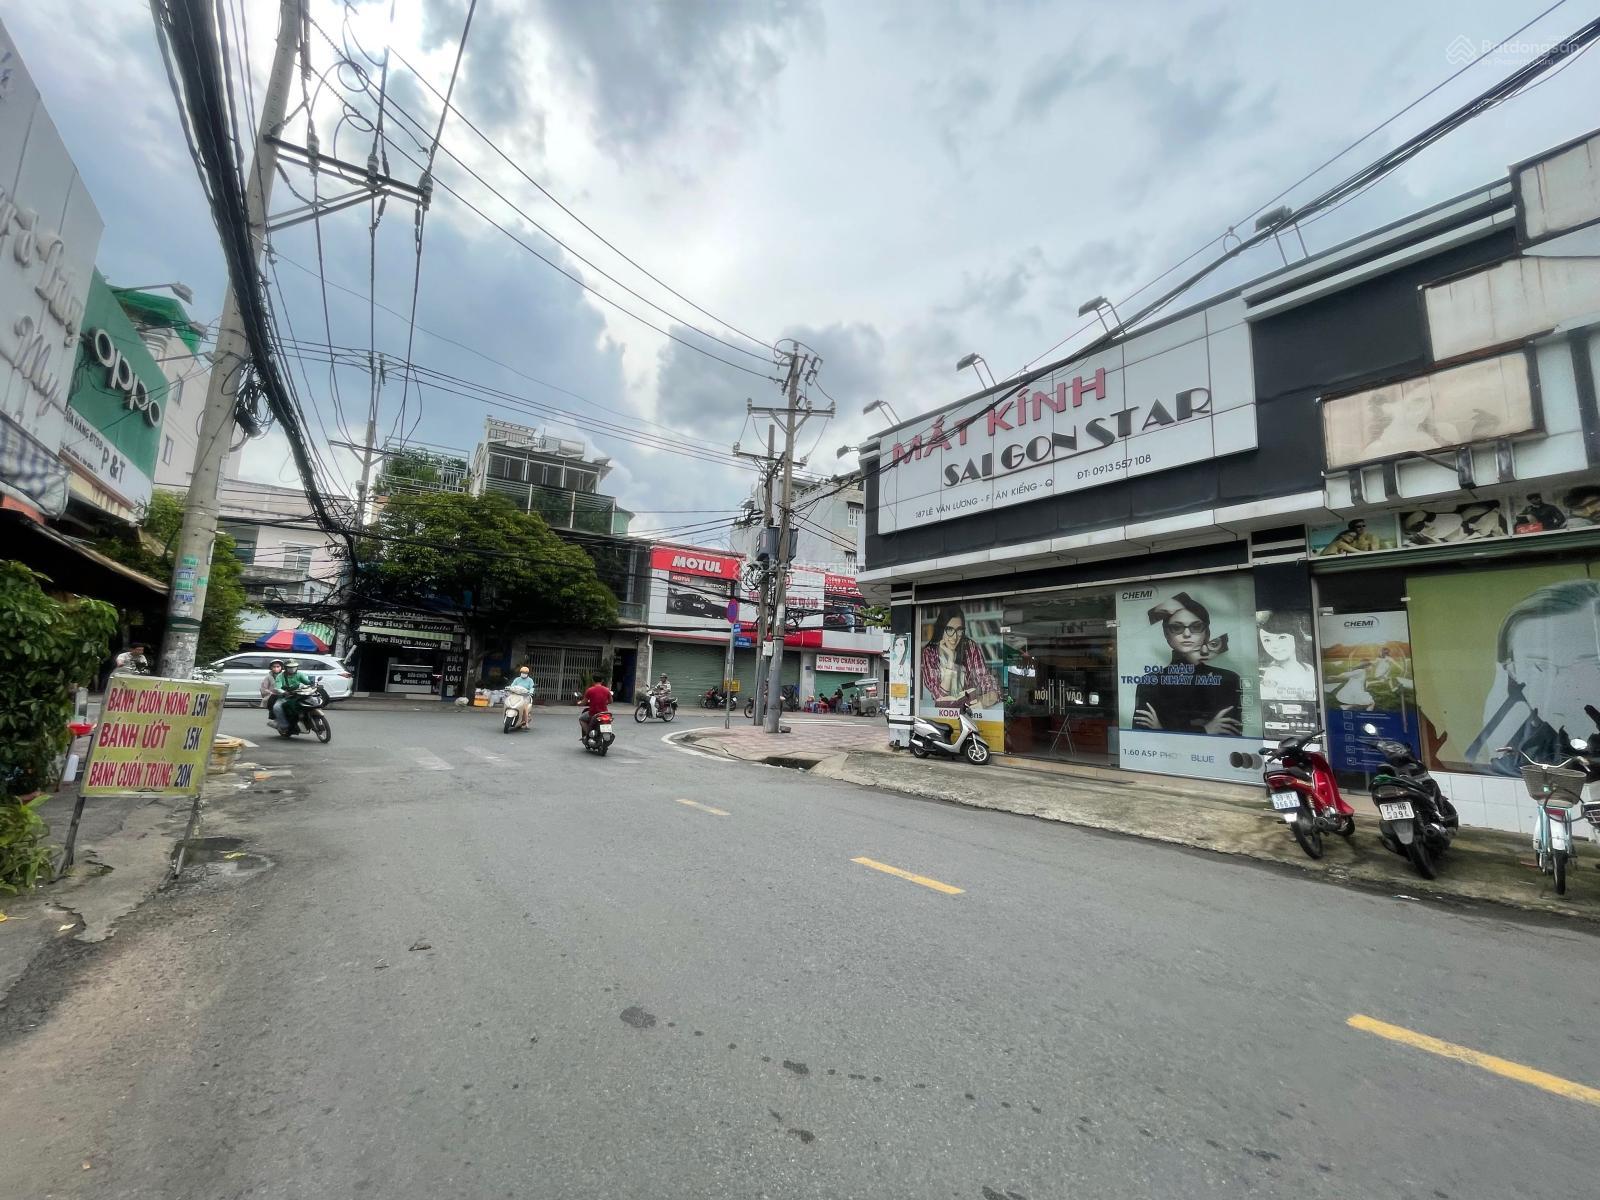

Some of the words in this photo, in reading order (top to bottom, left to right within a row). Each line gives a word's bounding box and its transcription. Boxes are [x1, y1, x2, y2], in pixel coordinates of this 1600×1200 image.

[986, 367, 1105, 437] KÍNH
[1086, 387, 1211, 447] STAR
[1092, 463, 1113, 475] 0913
[1115, 458, 1133, 470] 557
[1134, 454, 1152, 465] 108
[672, 555, 722, 573] MOTUL
[1121, 590, 1152, 600] CHEMI
[1343, 620, 1374, 628] CHEMI
[1167, 662, 1195, 675] MÀU
[1121, 675, 1159, 685] TRONG
[191, 693, 210, 717] 15K
[938, 709, 961, 717] KODA
[98, 717, 140, 748] BÁNH
[141, 718, 172, 749] ƯỚT
[183, 727, 202, 751] 15K
[1191, 754, 1215, 763] BLUE
[88, 755, 117, 787] BÁNH
[174, 764, 194, 788] 20K
